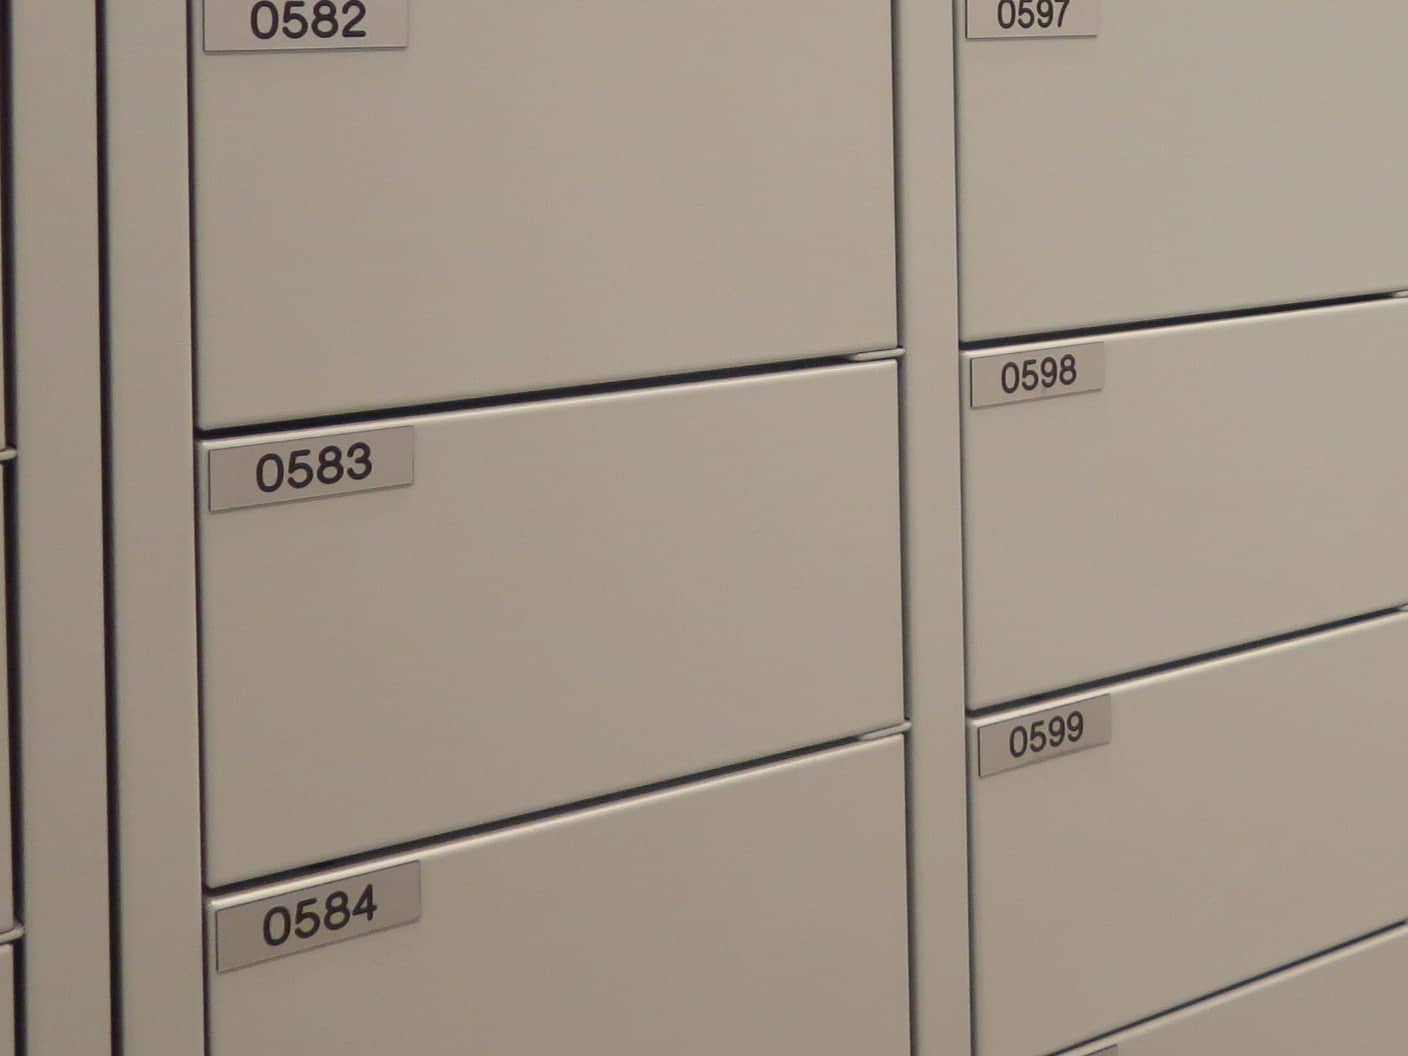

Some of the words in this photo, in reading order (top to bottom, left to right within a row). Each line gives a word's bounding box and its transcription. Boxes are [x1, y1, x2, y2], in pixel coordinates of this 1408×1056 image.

[251, 0, 366, 39] 0582
[1002, 354, 1076, 393] 0598
[256, 442, 372, 492] 0583
[1010, 711, 1083, 757] 0599
[263, 884, 377, 946] 0584
